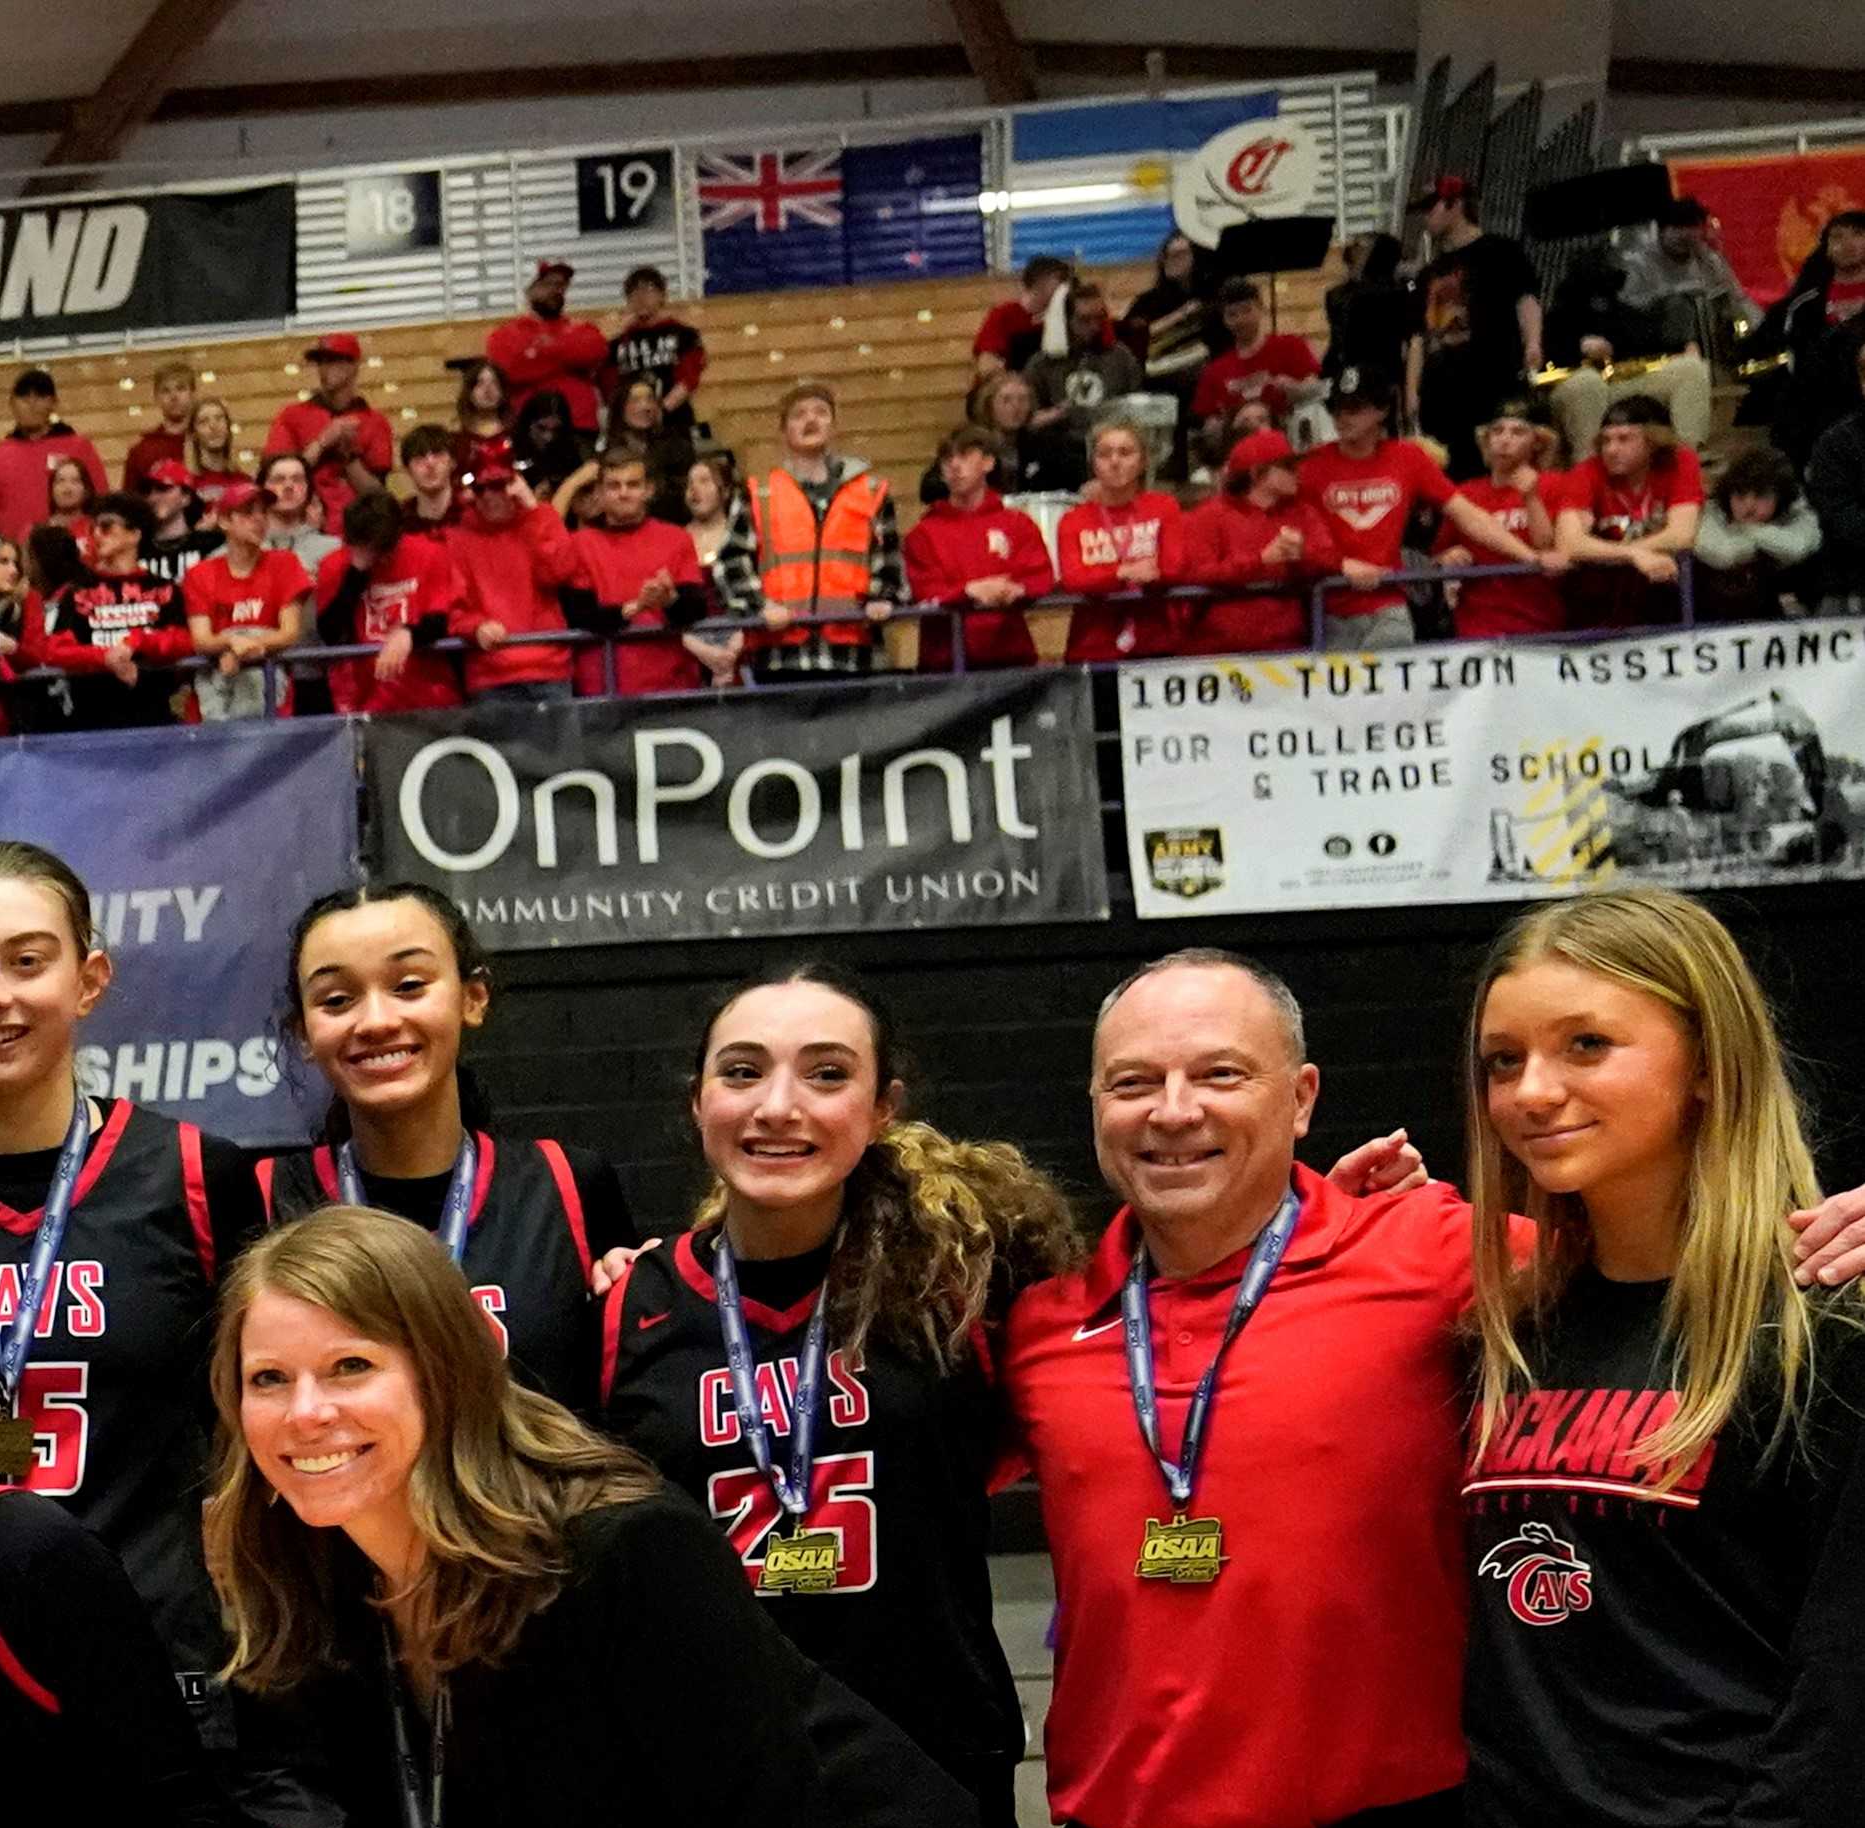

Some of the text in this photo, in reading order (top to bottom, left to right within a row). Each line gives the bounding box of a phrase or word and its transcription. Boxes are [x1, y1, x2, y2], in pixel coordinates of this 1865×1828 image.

[370, 188, 417, 236] 18
[594, 162, 657, 222] 19
[1131, 653, 1517, 709] 100% TUITION
[1135, 721, 1449, 766] FOR COLLEGE
[399, 714, 1040, 871] OnPoint
[1316, 763, 1453, 798] TRADE
[1490, 747, 1658, 784] SCHOOL
[706, 867, 1041, 914] CREDIT UNION
[707, 1450, 878, 1597] 25
[1144, 1536, 1218, 1560] OSAA
[767, 1549, 834, 1572] OSAA
[1507, 1556, 1593, 1626] CAVS
